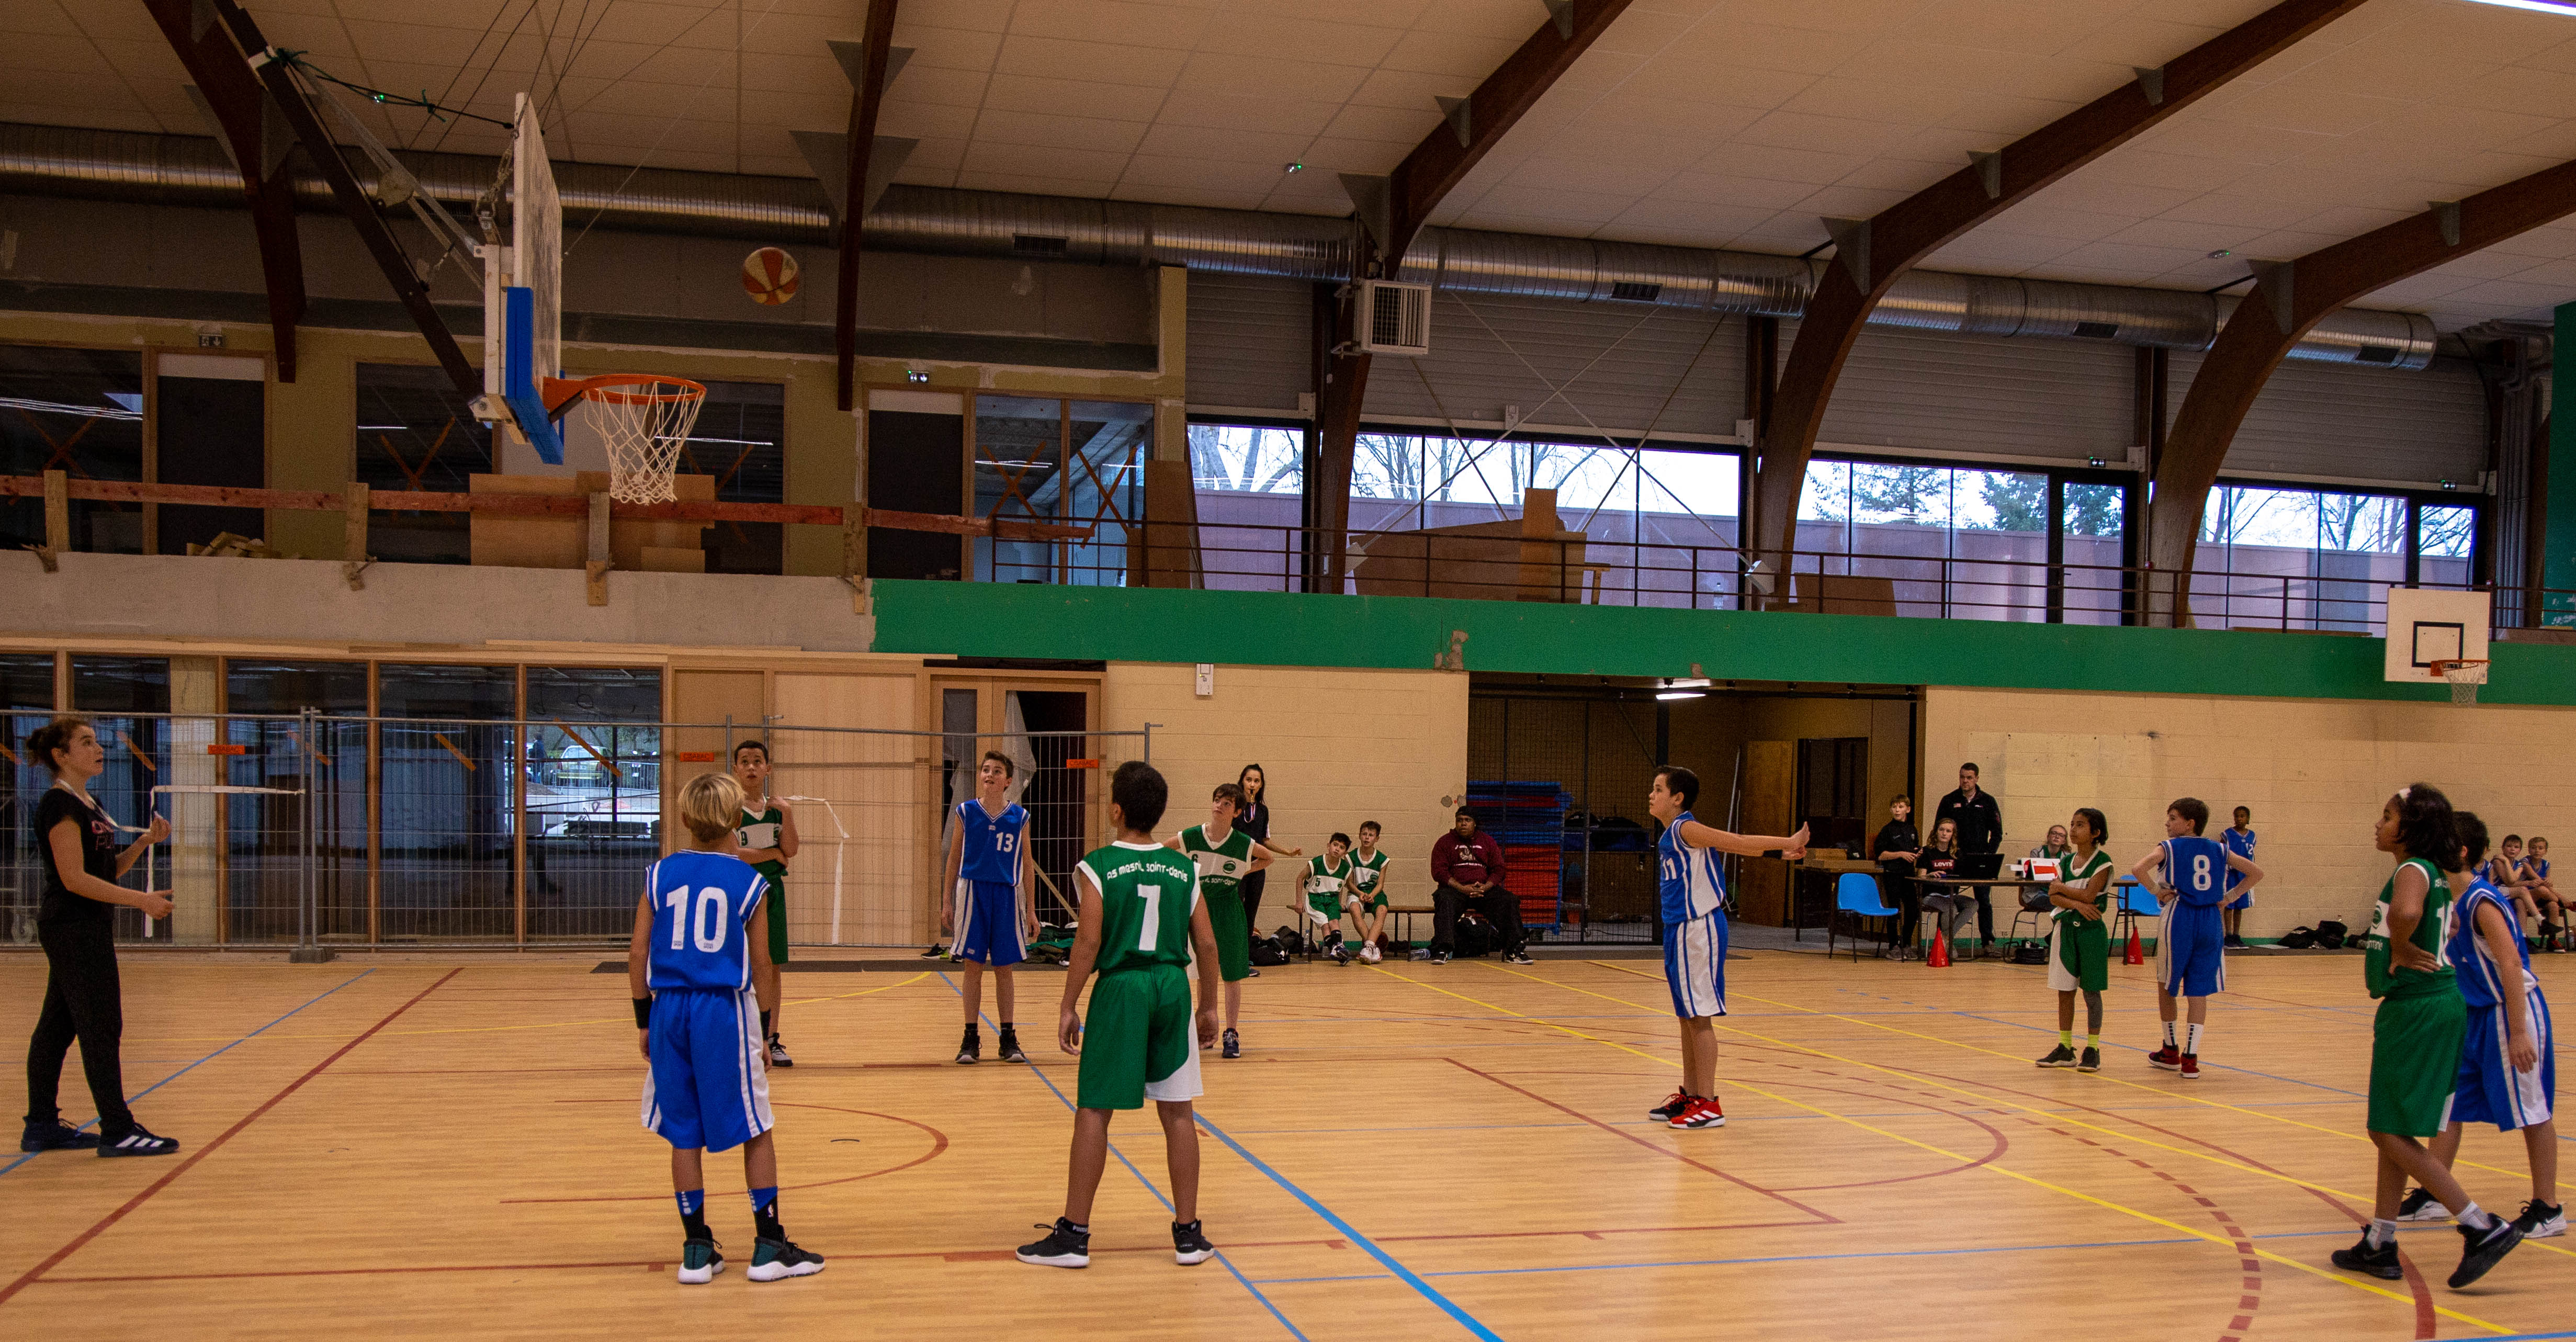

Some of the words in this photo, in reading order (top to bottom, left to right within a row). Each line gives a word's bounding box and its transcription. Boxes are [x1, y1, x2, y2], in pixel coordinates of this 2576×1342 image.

[996, 832, 1014, 852] 13
[1663, 858, 1677, 881] 11
[2194, 854, 2211, 891] 8
[1315, 877, 1321, 887] 5
[666, 884, 728, 953] 10
